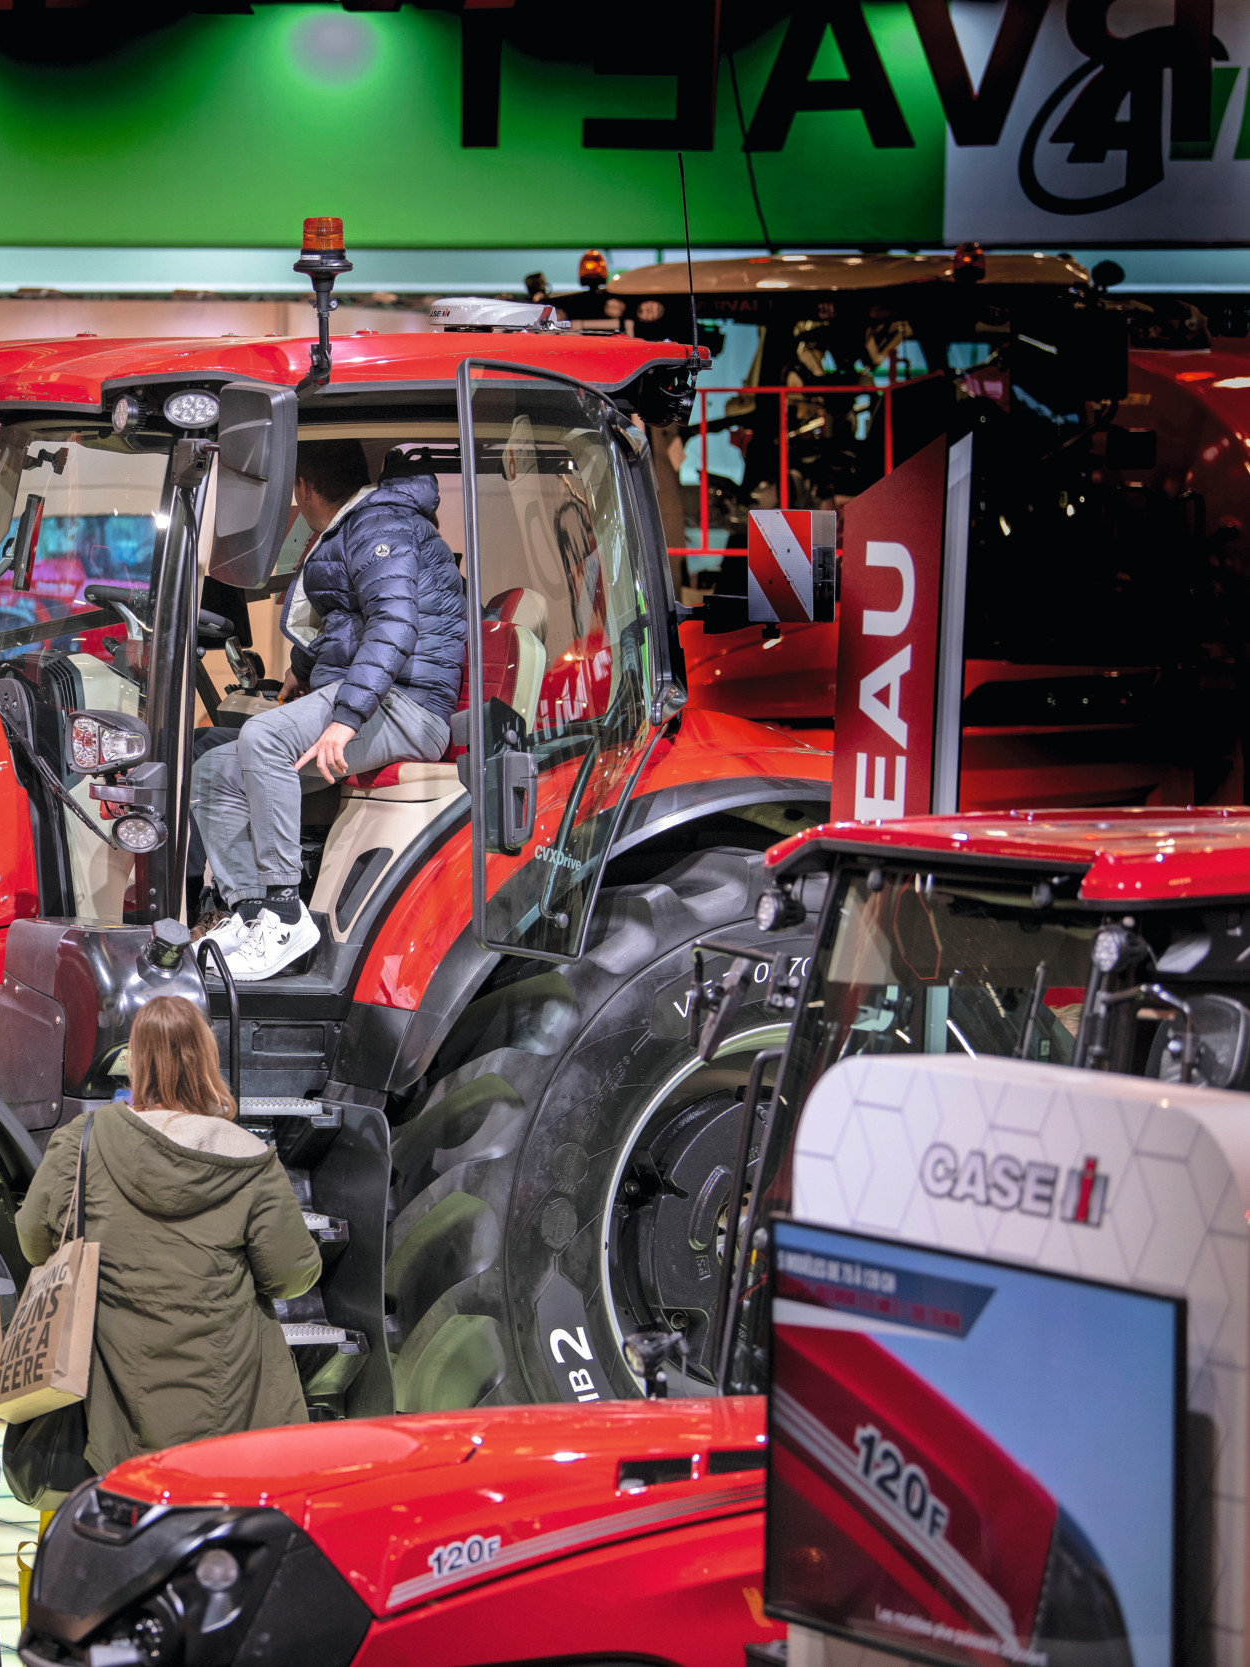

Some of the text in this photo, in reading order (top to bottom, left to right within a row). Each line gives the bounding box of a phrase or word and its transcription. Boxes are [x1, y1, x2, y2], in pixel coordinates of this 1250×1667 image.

[854, 541, 915, 820] EAU
[534, 845, 582, 871] CVXDrive
[919, 1142, 1059, 1219] CASE
[9, 1283, 63, 1336] RUNS
[0, 1321, 50, 1367] LIKE A
[550, 1326, 594, 1365] 2
[856, 1428, 948, 1538] 120F
[430, 1537, 500, 1576] 120F
